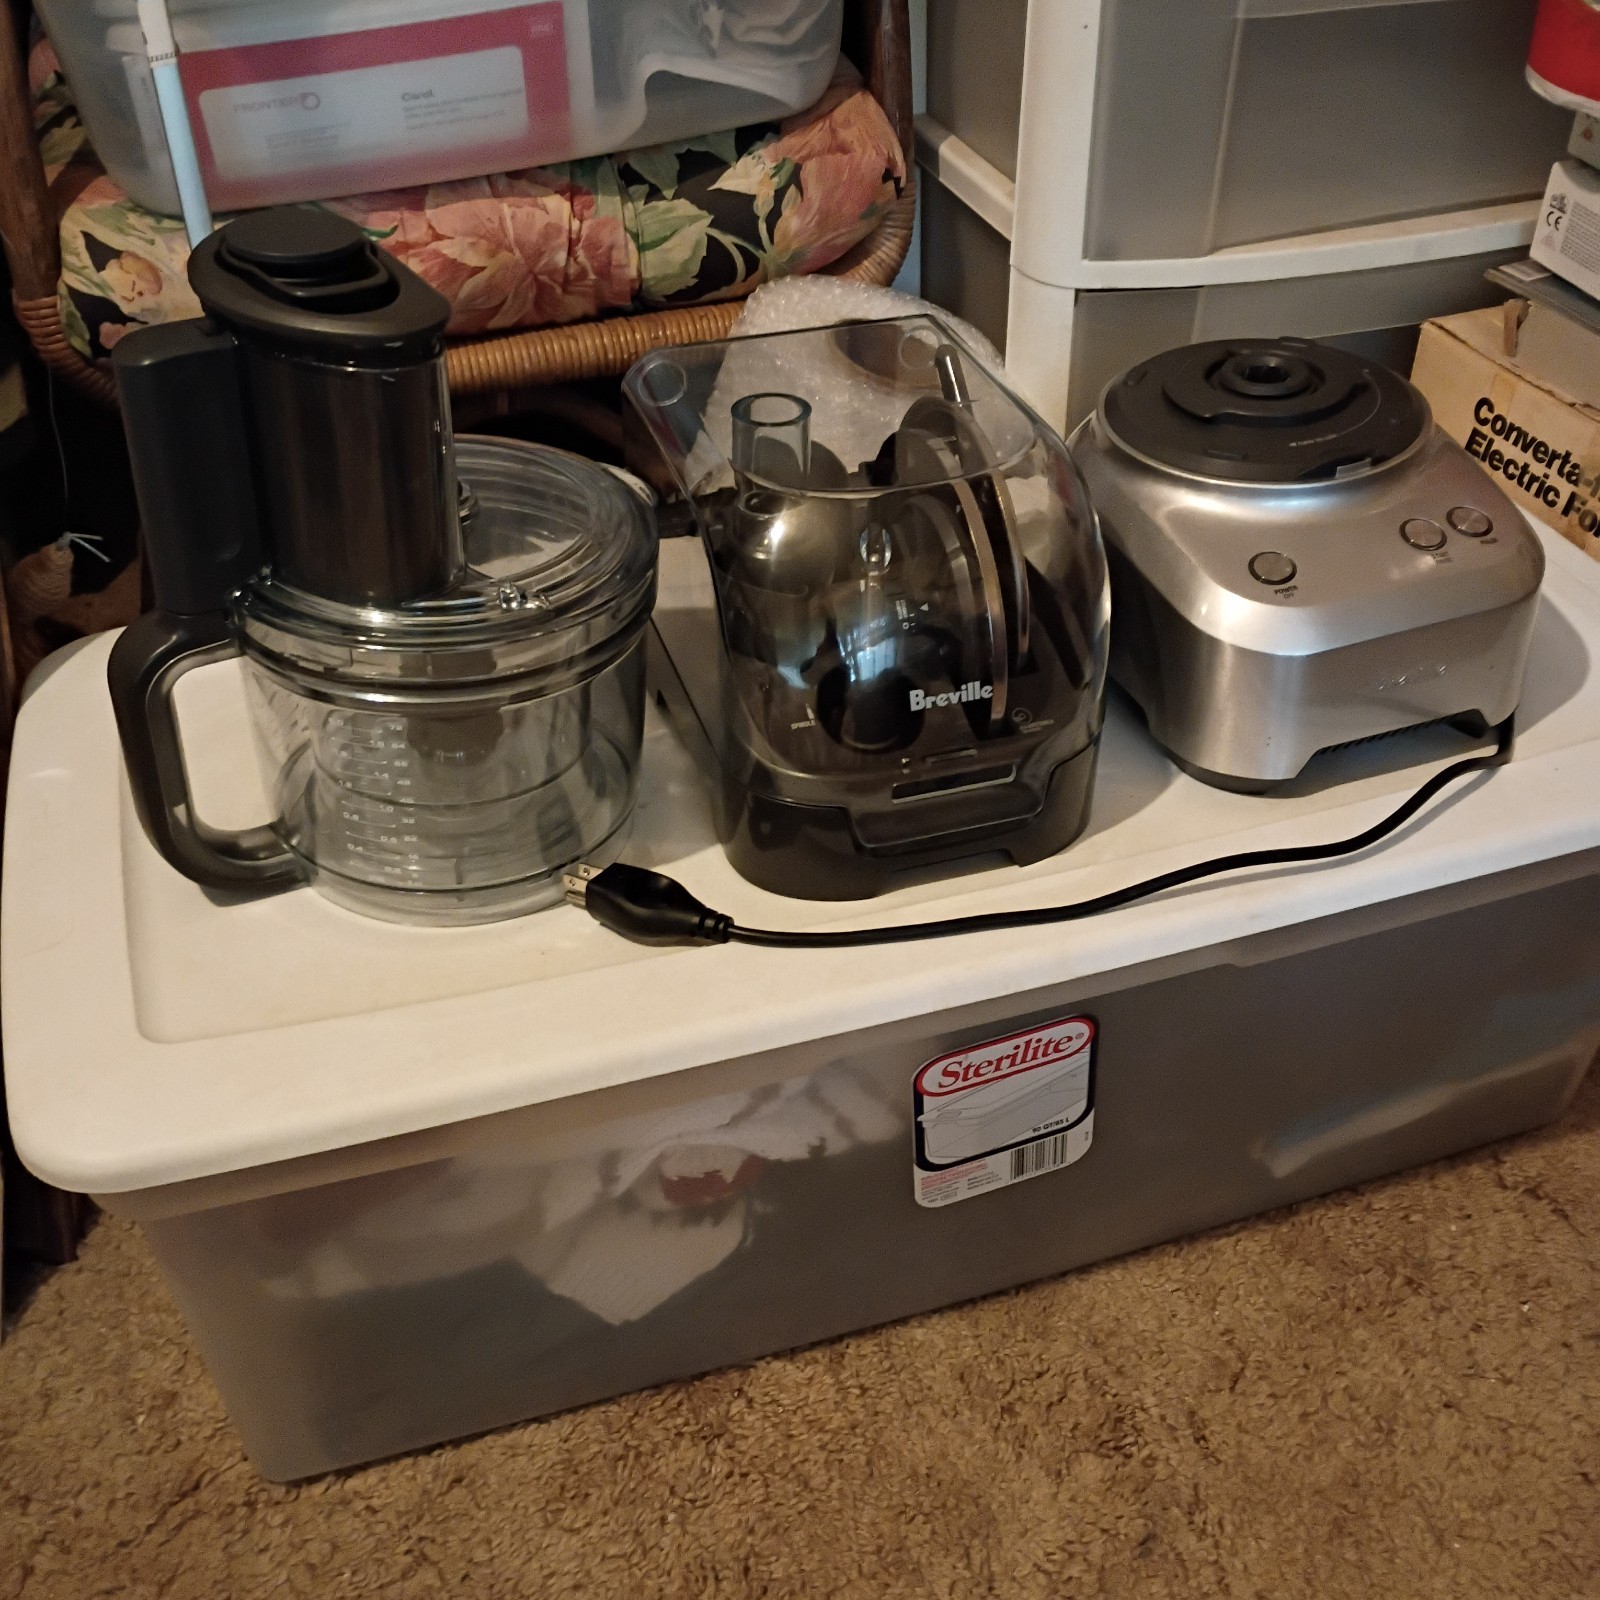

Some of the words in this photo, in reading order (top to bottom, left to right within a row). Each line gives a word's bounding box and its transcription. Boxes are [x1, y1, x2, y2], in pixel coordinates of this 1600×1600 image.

[1464, 426, 1561, 508] Electric
[1273, 585, 1299, 595] POWER
[909, 680, 993, 711] Breville
